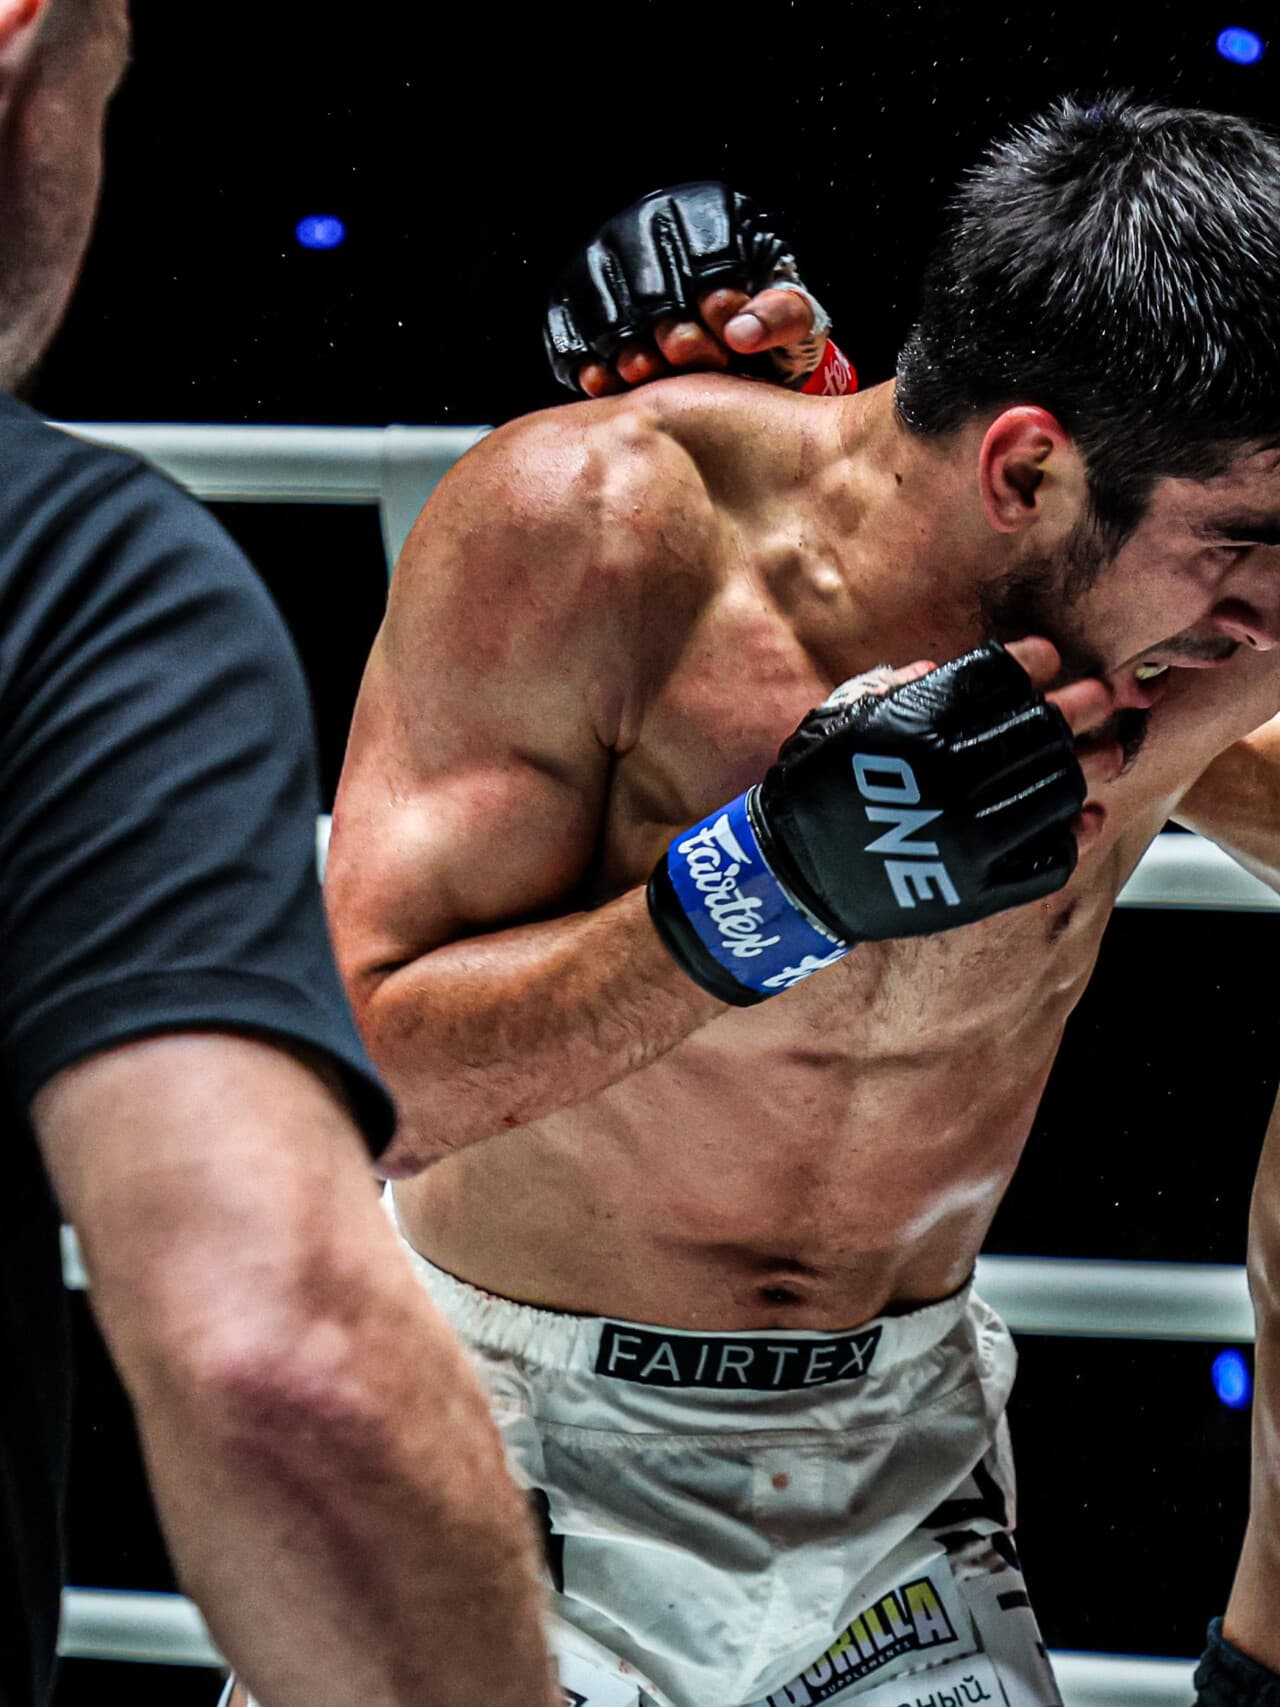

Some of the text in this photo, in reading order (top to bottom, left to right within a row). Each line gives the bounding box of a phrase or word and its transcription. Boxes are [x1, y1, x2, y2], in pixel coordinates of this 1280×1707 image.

[852, 752, 961, 909] ONE
[677, 813, 781, 958] Fairtex
[607, 1333, 875, 1385] FAIRTEX
[820, 1639, 912, 1696] SUPPLEMENTS
